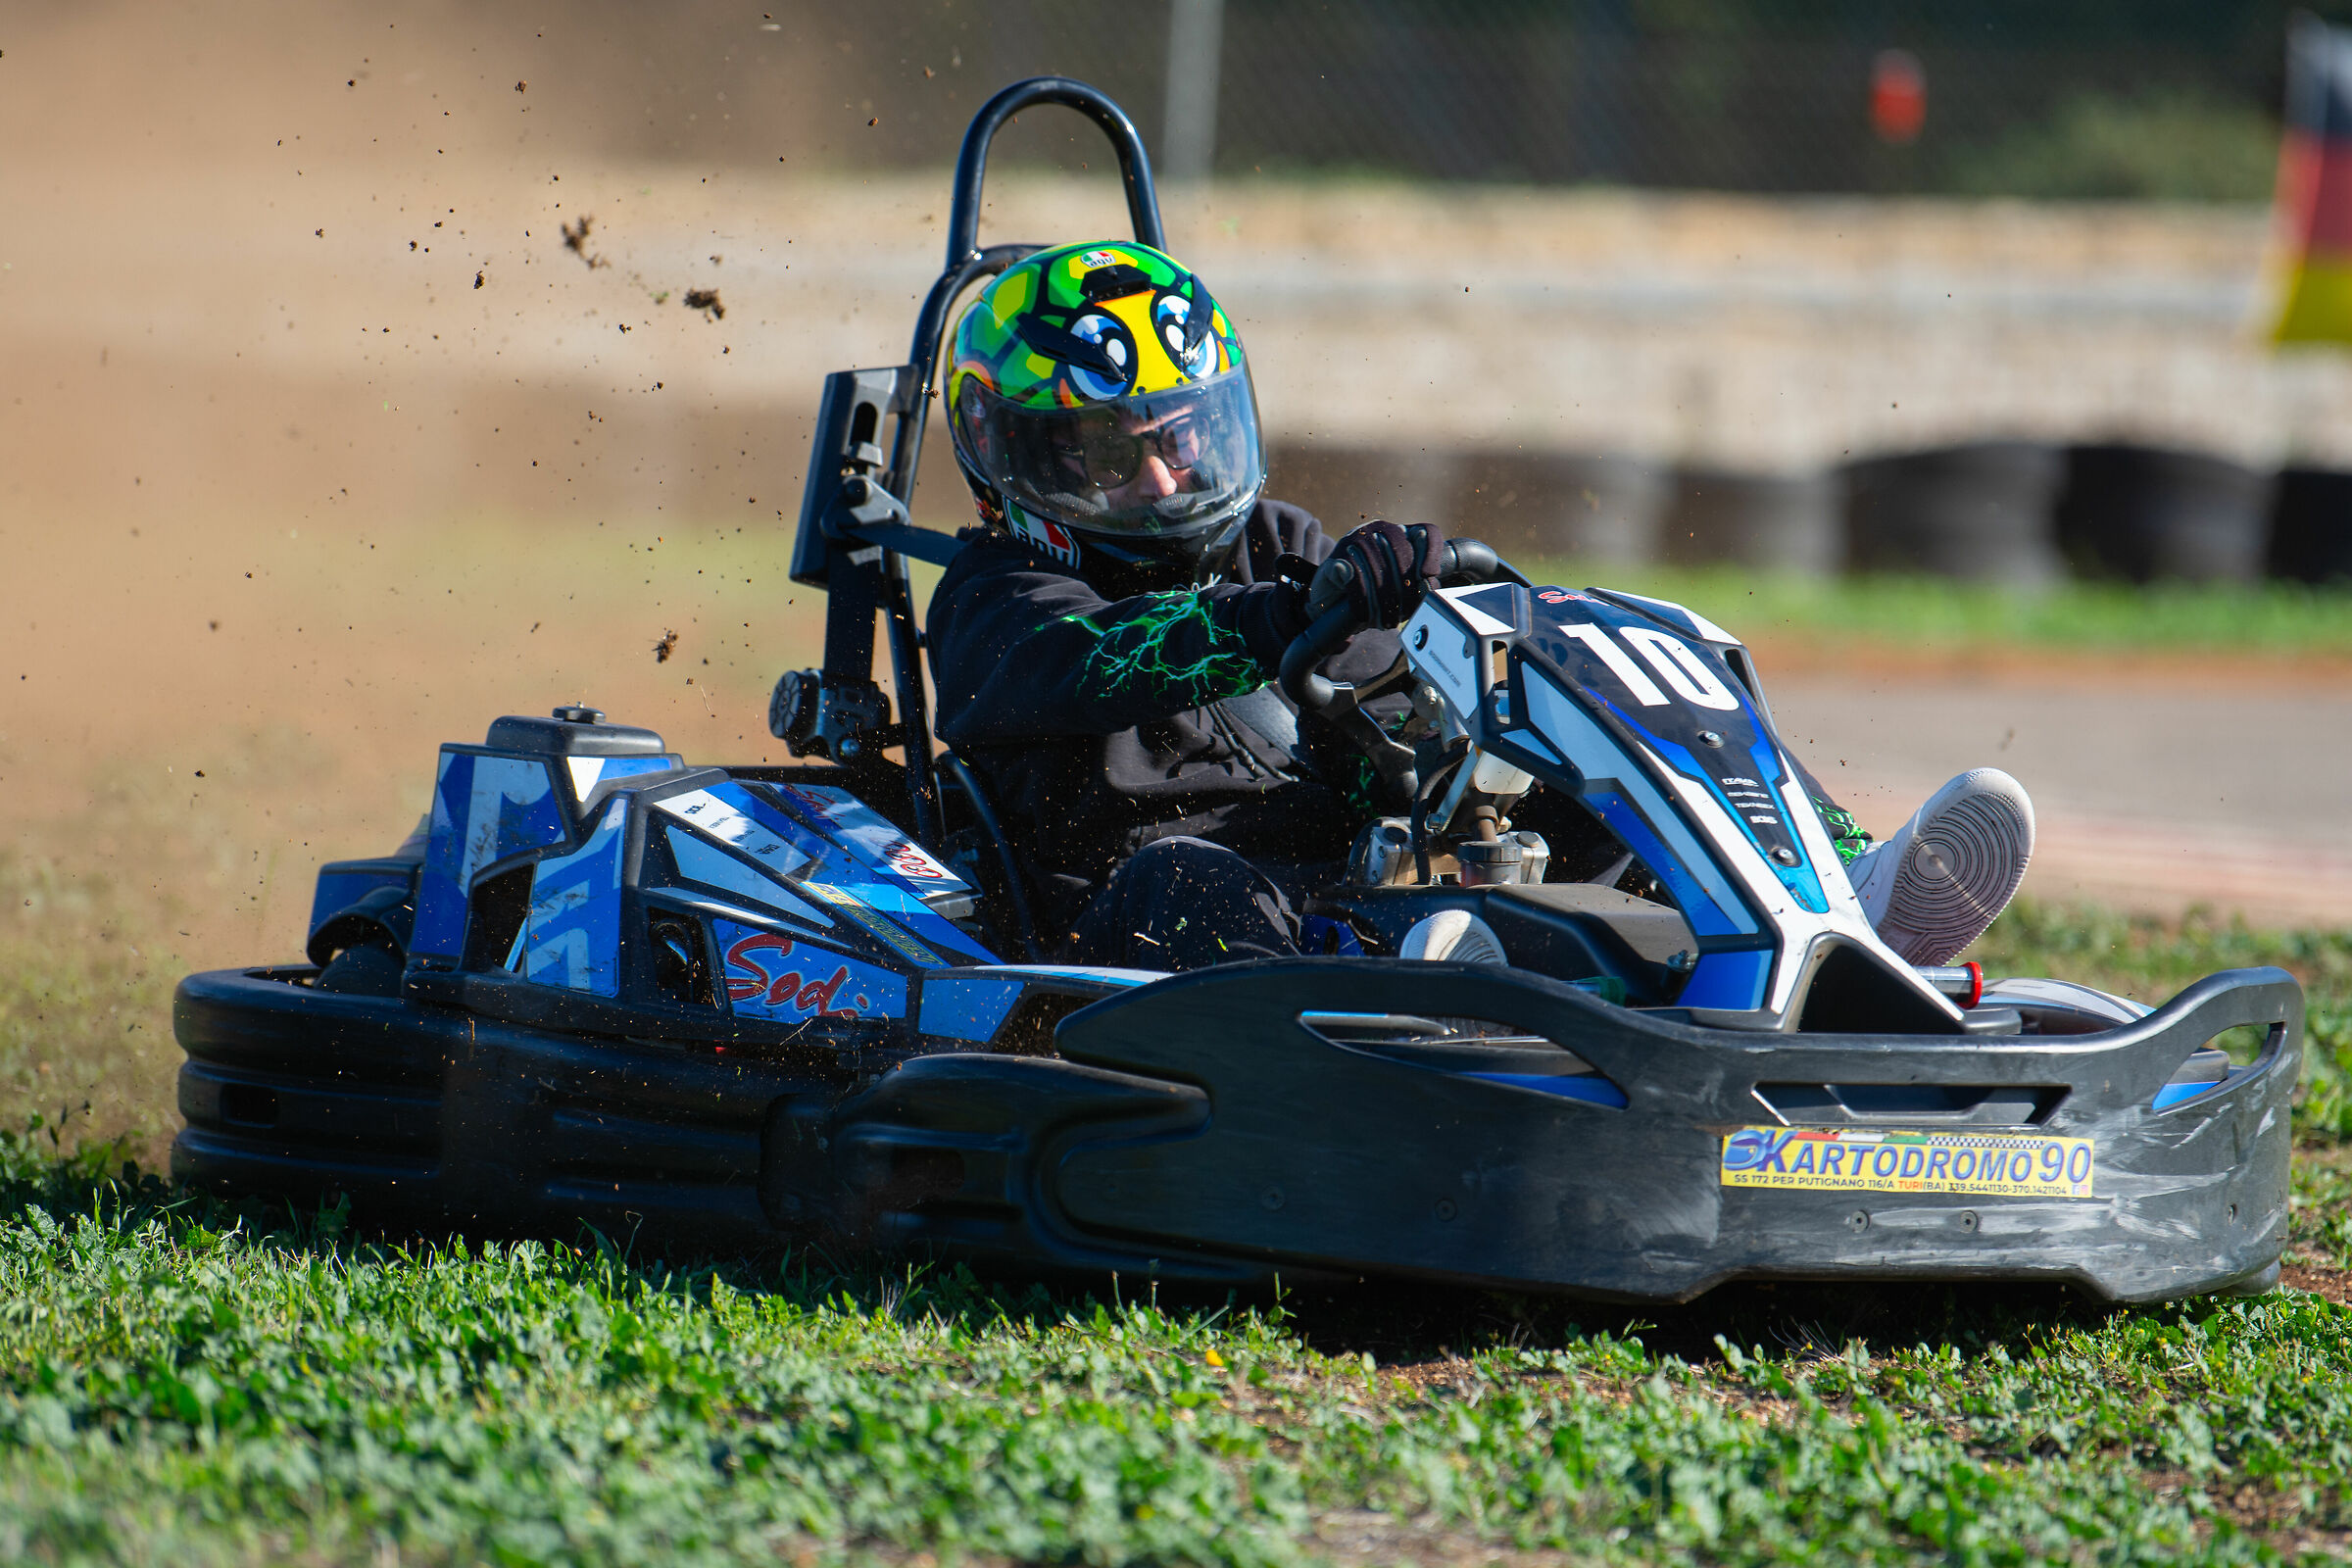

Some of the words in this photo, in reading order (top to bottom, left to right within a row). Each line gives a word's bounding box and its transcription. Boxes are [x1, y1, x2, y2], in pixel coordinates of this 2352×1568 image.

[1558, 622, 1740, 710] 10
[1735, 1174, 1747, 1183] SS
[1752, 1175, 1768, 1184] 172
[1773, 1176, 1794, 1185] PER
[1798, 1177, 1865, 1188] PUTIGNANO
